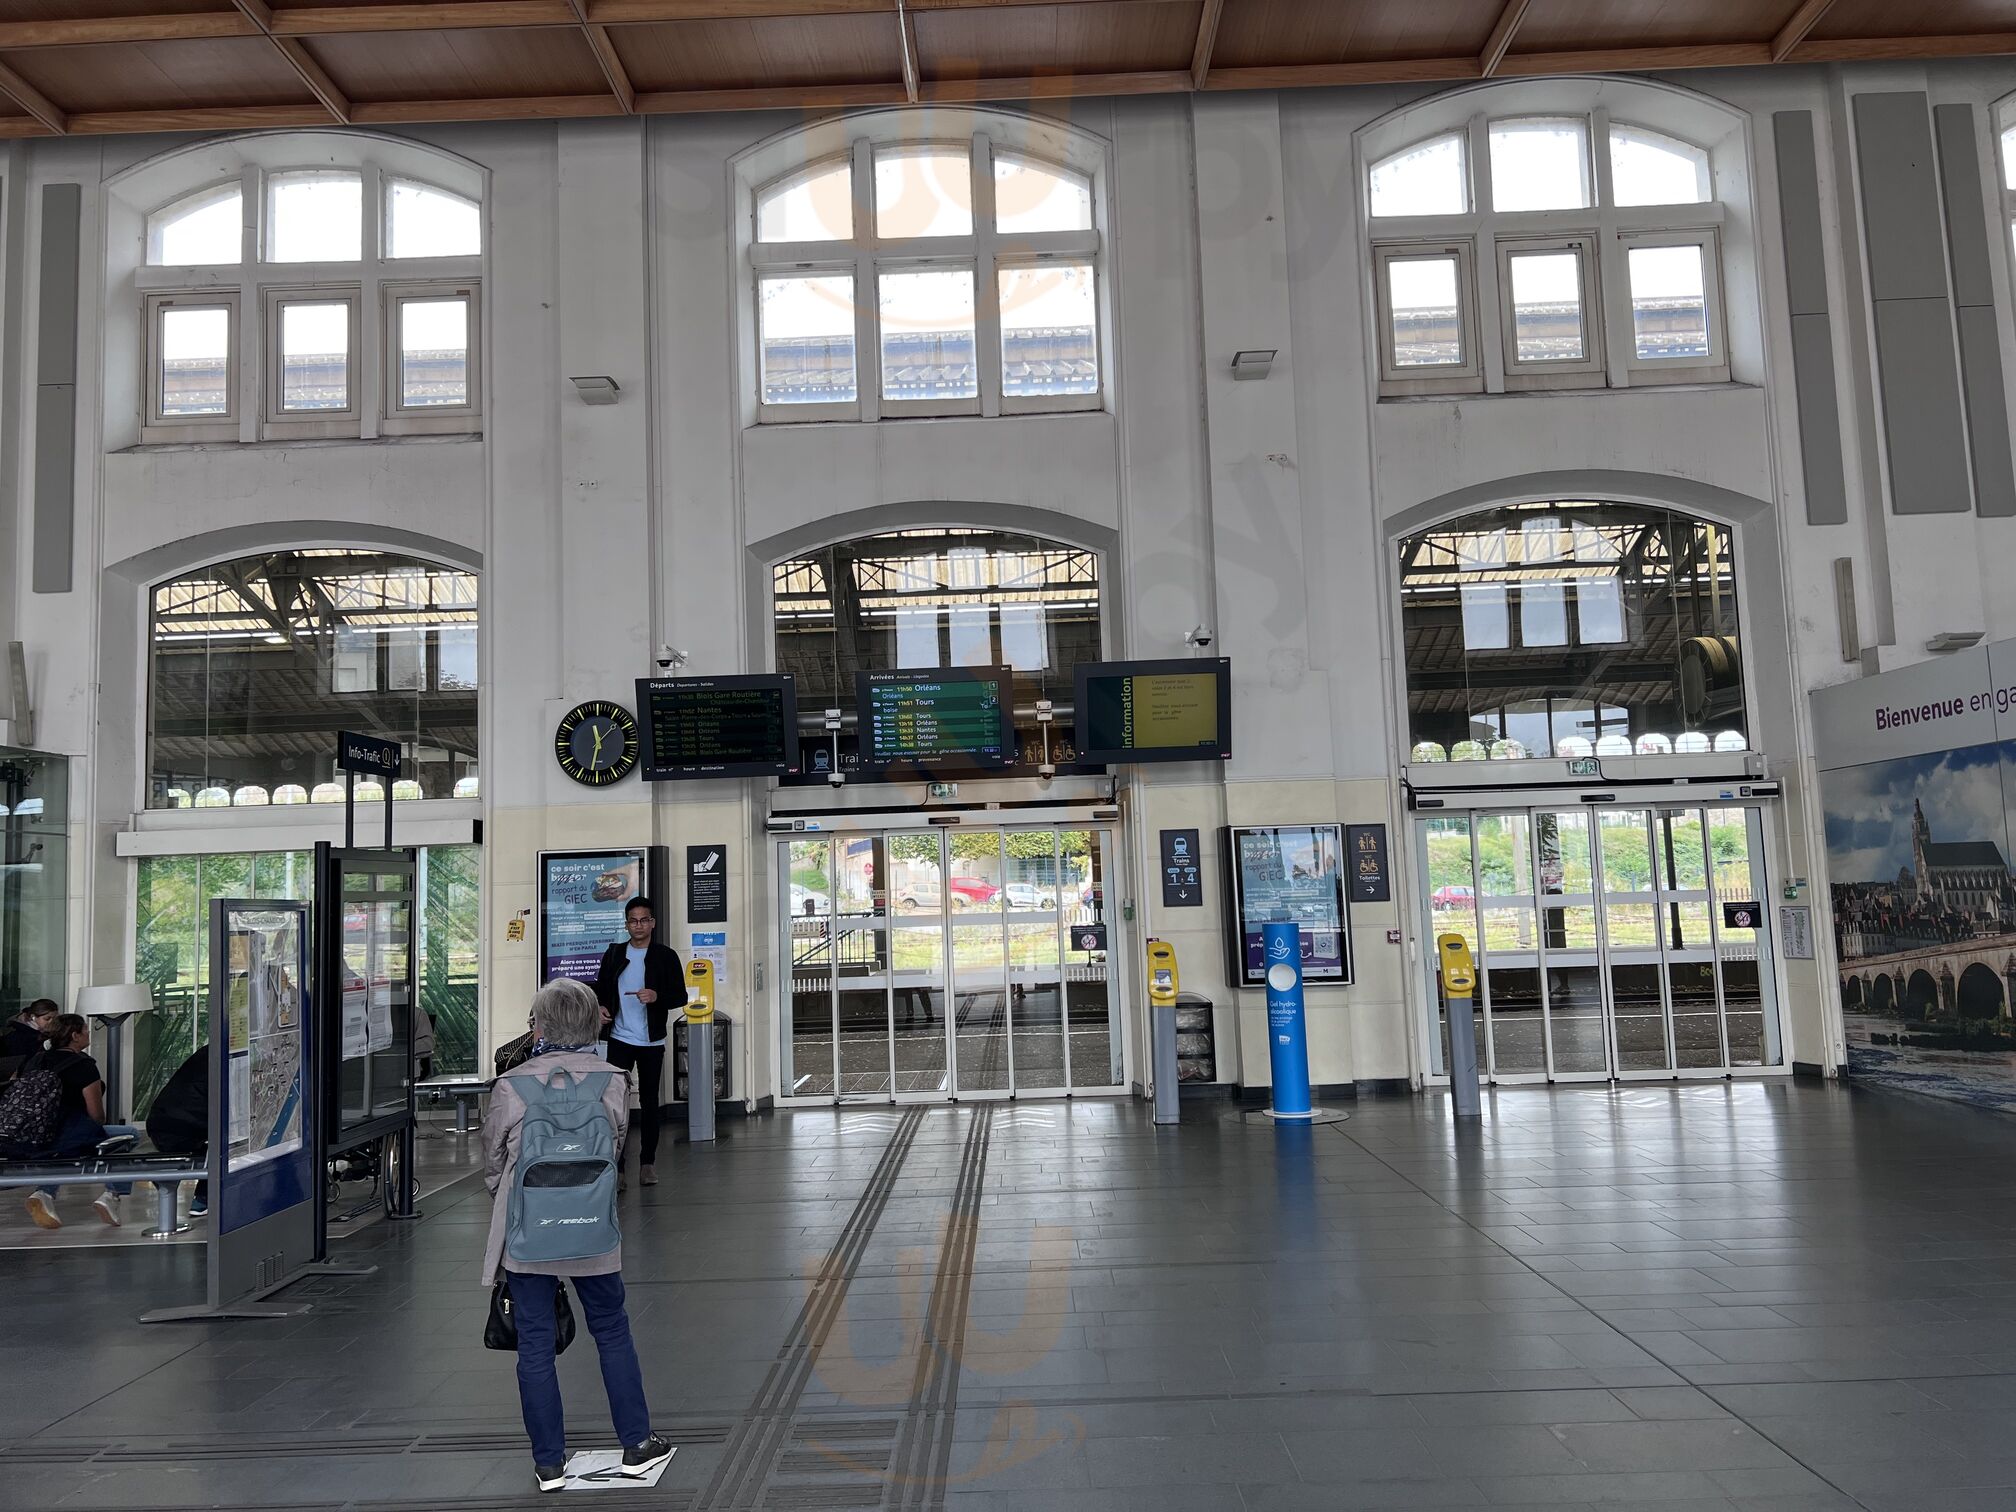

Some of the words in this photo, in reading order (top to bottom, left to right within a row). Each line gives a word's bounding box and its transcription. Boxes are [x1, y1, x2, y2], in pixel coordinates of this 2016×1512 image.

[650, 681, 674, 689] Départs
[915, 684, 941, 692] Orléans
[731, 690, 761, 699] Routière
[697, 706, 722, 714] Nantes
[1121, 678, 1132, 748] information
[1875, 697, 1964, 731] Bienvenue
[1970, 692, 1992, 712] en
[348, 745, 381, 763] Info-Trafic
[1171, 874, 1177, 883] 1
[1187, 874, 1194, 882] 4
[1259, 870, 1282, 881] GIEC
[552, 885, 578, 895] rapport
[565, 894, 587, 904] GIEC
[1279, 1000, 1296, 1009] hydro-
[557, 1216, 600, 1225] reebok
